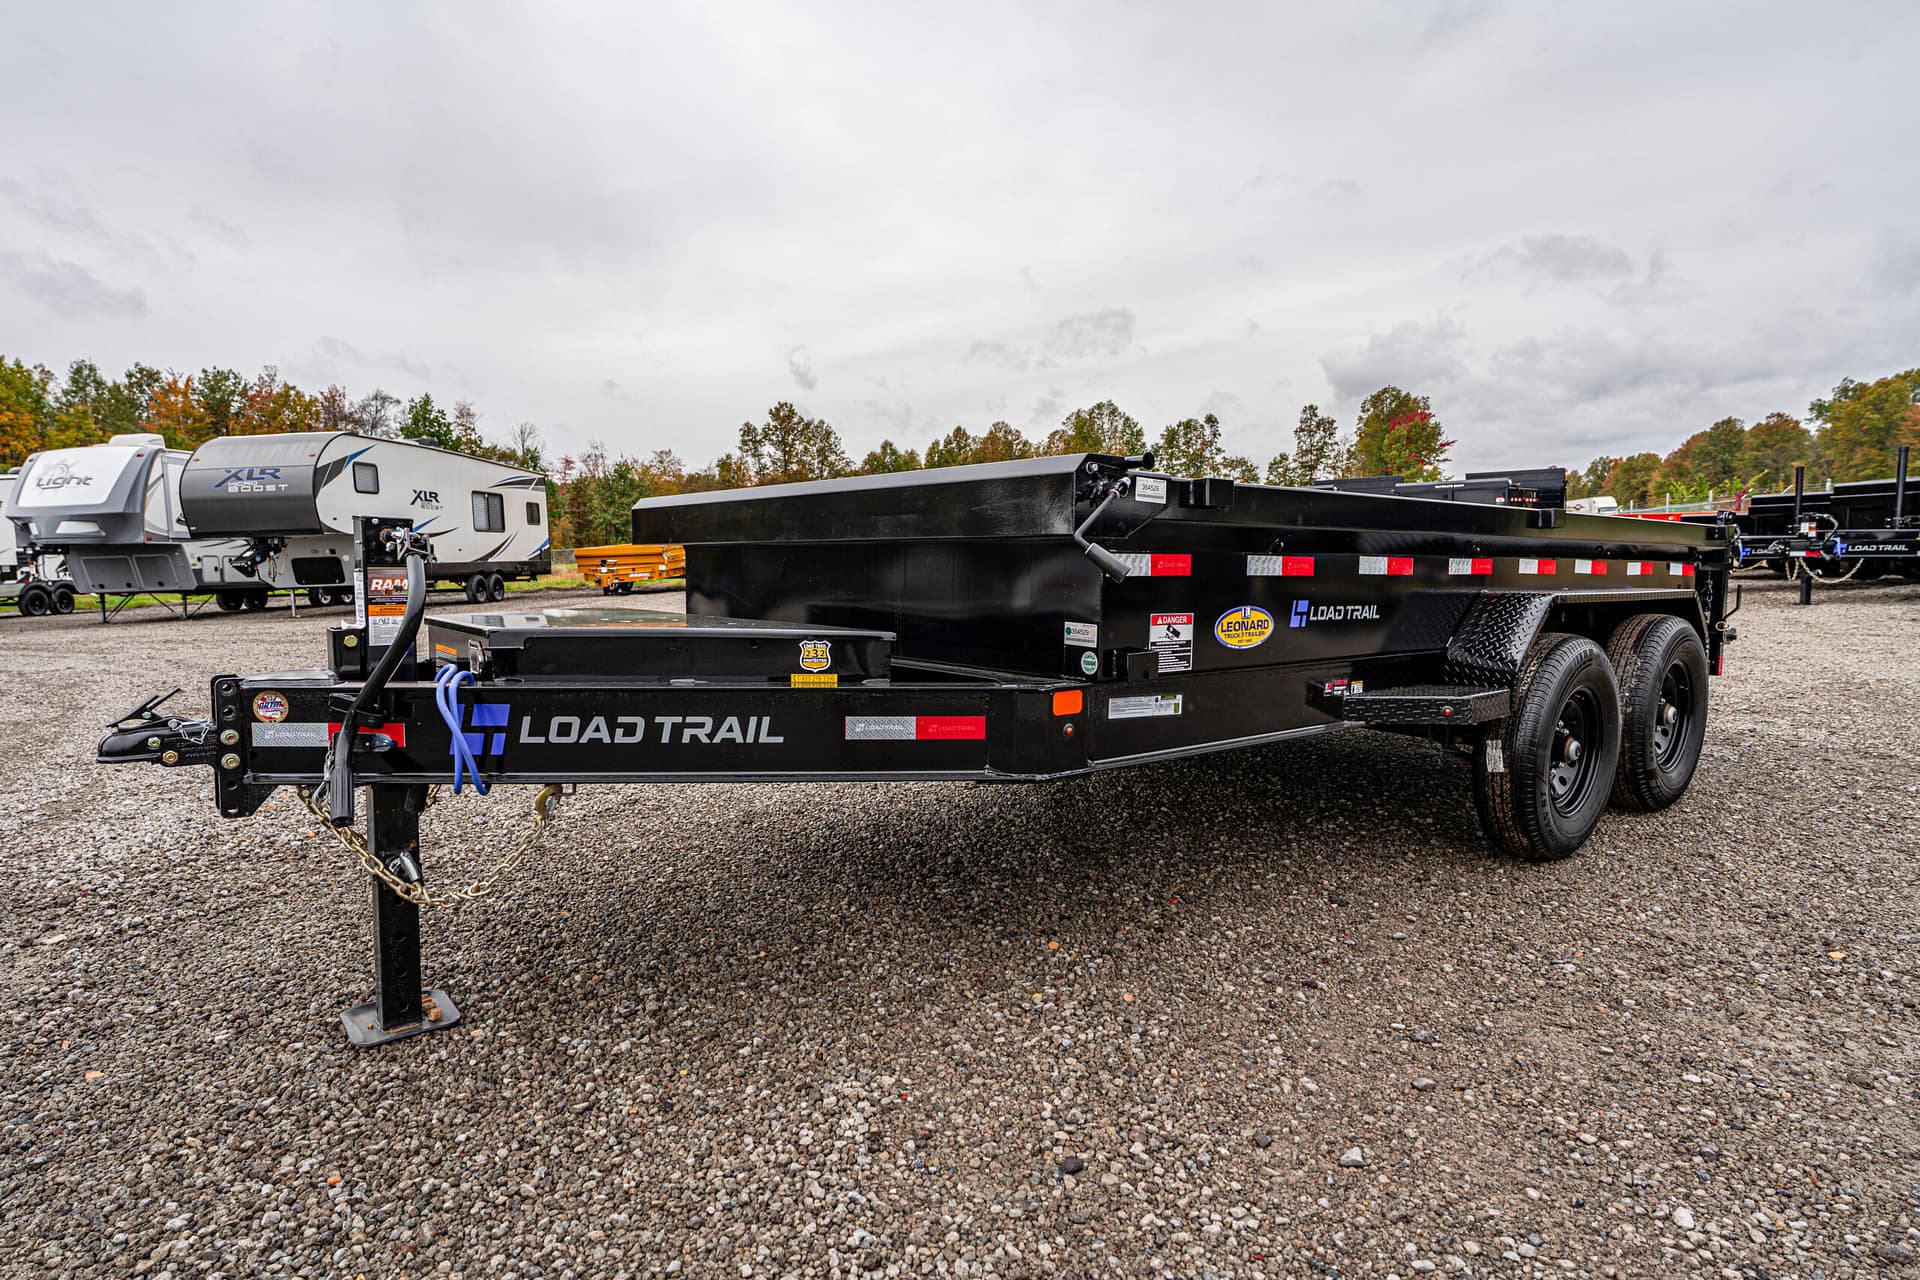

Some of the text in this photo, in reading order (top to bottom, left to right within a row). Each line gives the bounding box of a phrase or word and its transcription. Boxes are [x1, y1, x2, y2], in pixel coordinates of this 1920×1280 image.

[211, 467, 282, 489] XLR
[228, 484, 289, 493] BOOST
[410, 489, 440, 506] XLR
[370, 578, 408, 591] RAM
[1162, 616, 1188, 624] DANGER
[1309, 604, 1380, 621] LOAD TRAIL
[1220, 619, 1270, 633] LEONARD
[519, 716, 785, 744] LOAD TRAIL
